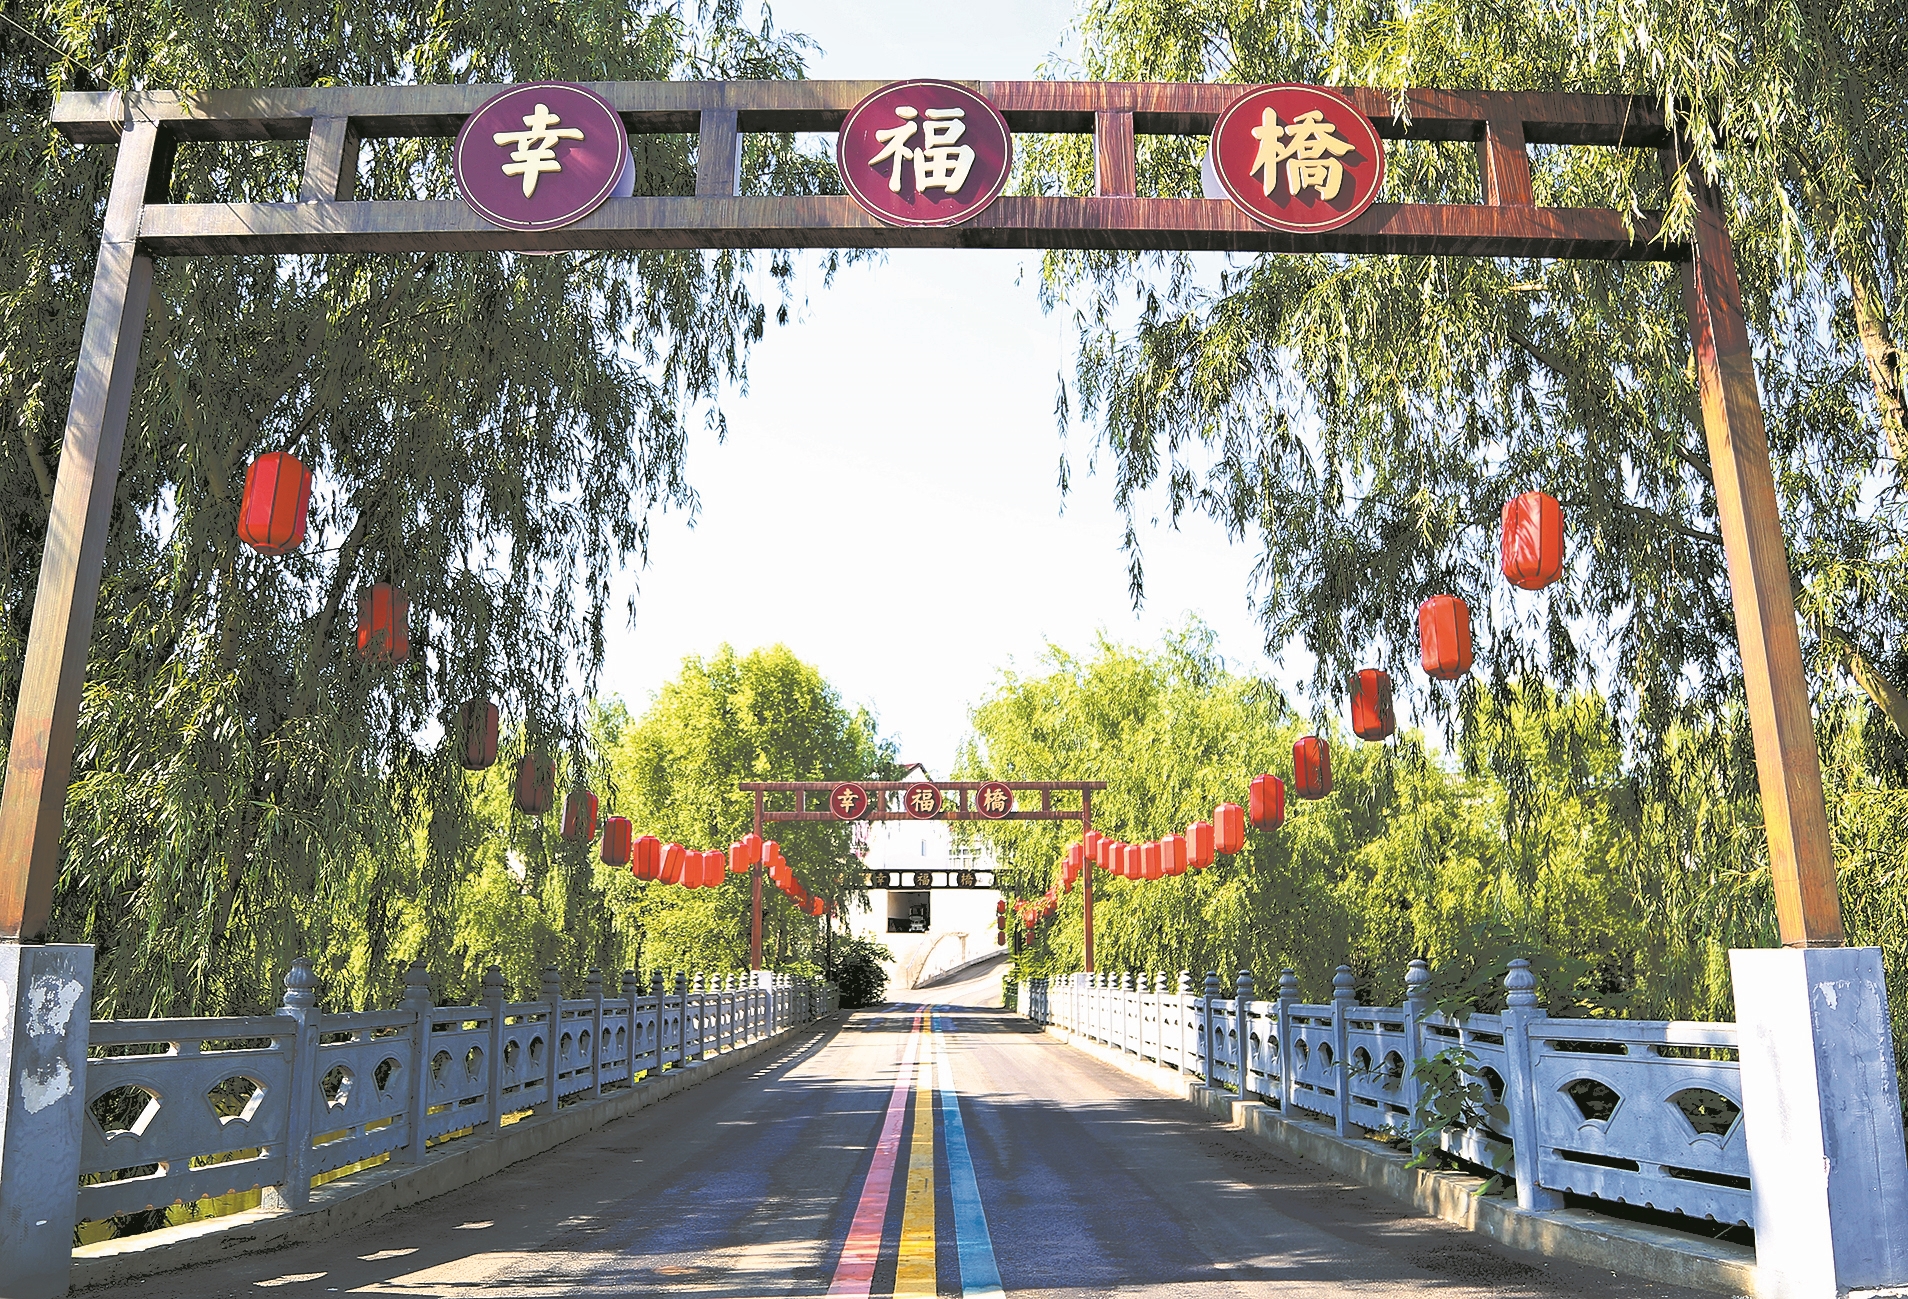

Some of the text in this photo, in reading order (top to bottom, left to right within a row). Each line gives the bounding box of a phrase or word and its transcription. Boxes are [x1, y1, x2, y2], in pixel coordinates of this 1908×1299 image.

[493, 103, 1356, 201] 幸福橋
[837, 788, 1008, 812] 幸福橋
